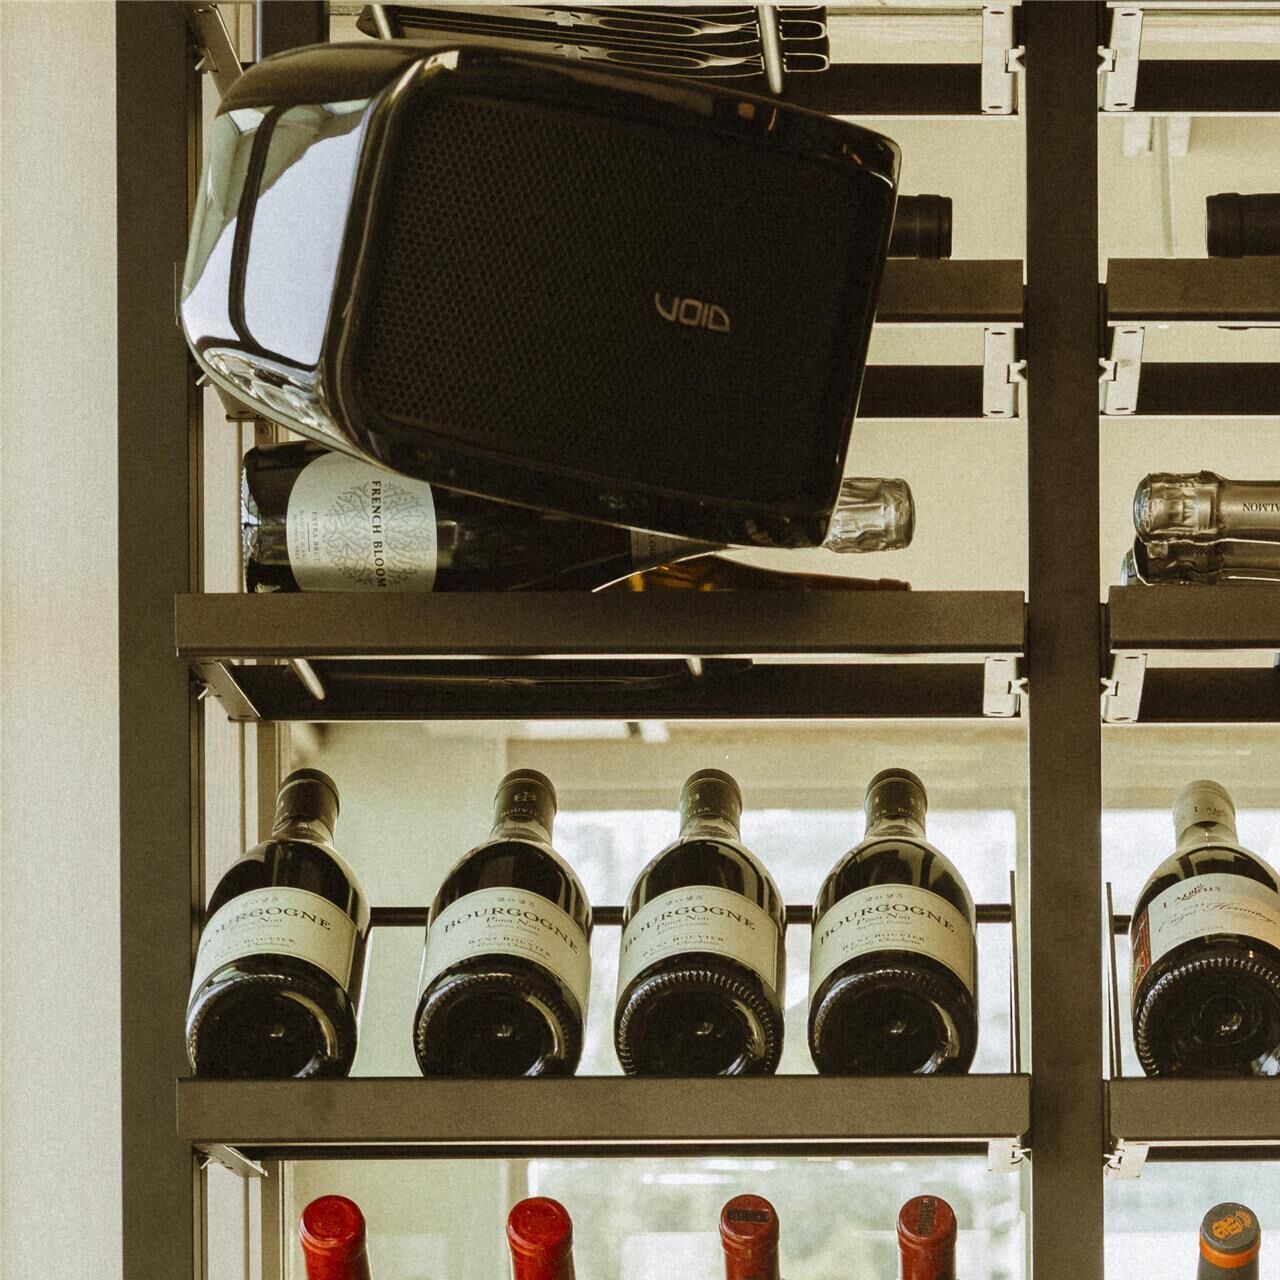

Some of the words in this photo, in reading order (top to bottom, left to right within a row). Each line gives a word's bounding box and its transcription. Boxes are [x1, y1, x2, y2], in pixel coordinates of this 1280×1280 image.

[655, 292, 730, 332] VOID
[371, 480, 383, 534] FRENCH
[372, 540, 387, 587] BLOOM
[444, 907, 578, 954] BOURGOGNE
[624, 905, 756, 953] BOURGOGNE
[820, 903, 956, 945] BOURGOGNE
